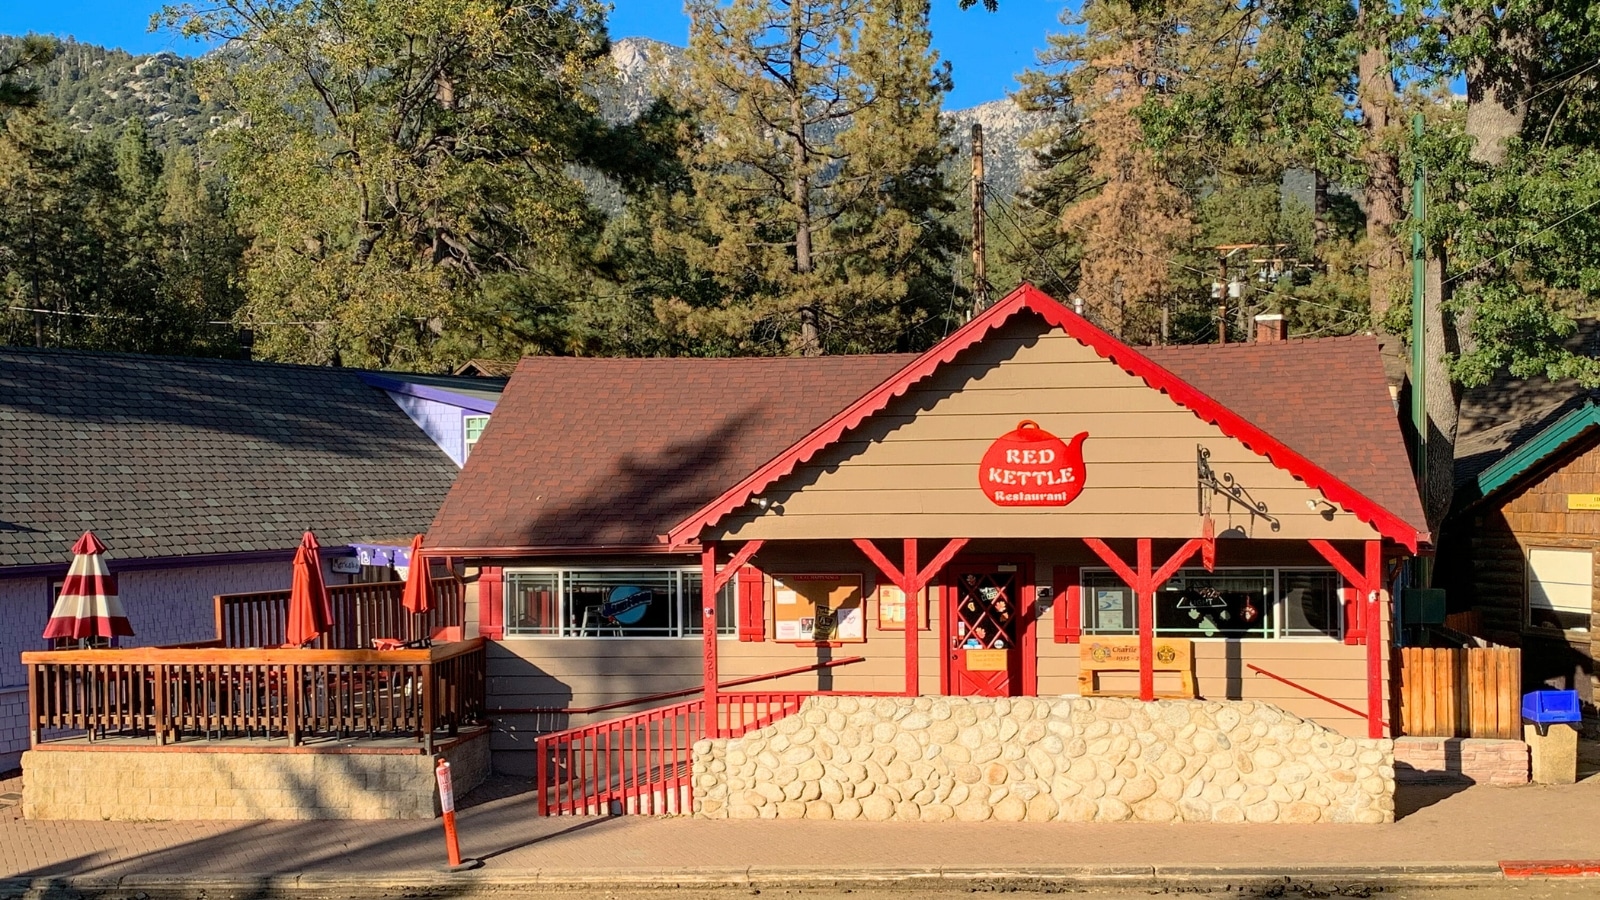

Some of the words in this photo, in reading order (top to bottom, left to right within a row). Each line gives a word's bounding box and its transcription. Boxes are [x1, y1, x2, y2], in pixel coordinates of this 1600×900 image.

[1006, 449, 1055, 464] RED
[989, 467, 1075, 486] KETTLE
[994, 491, 1067, 501] Restaurant
